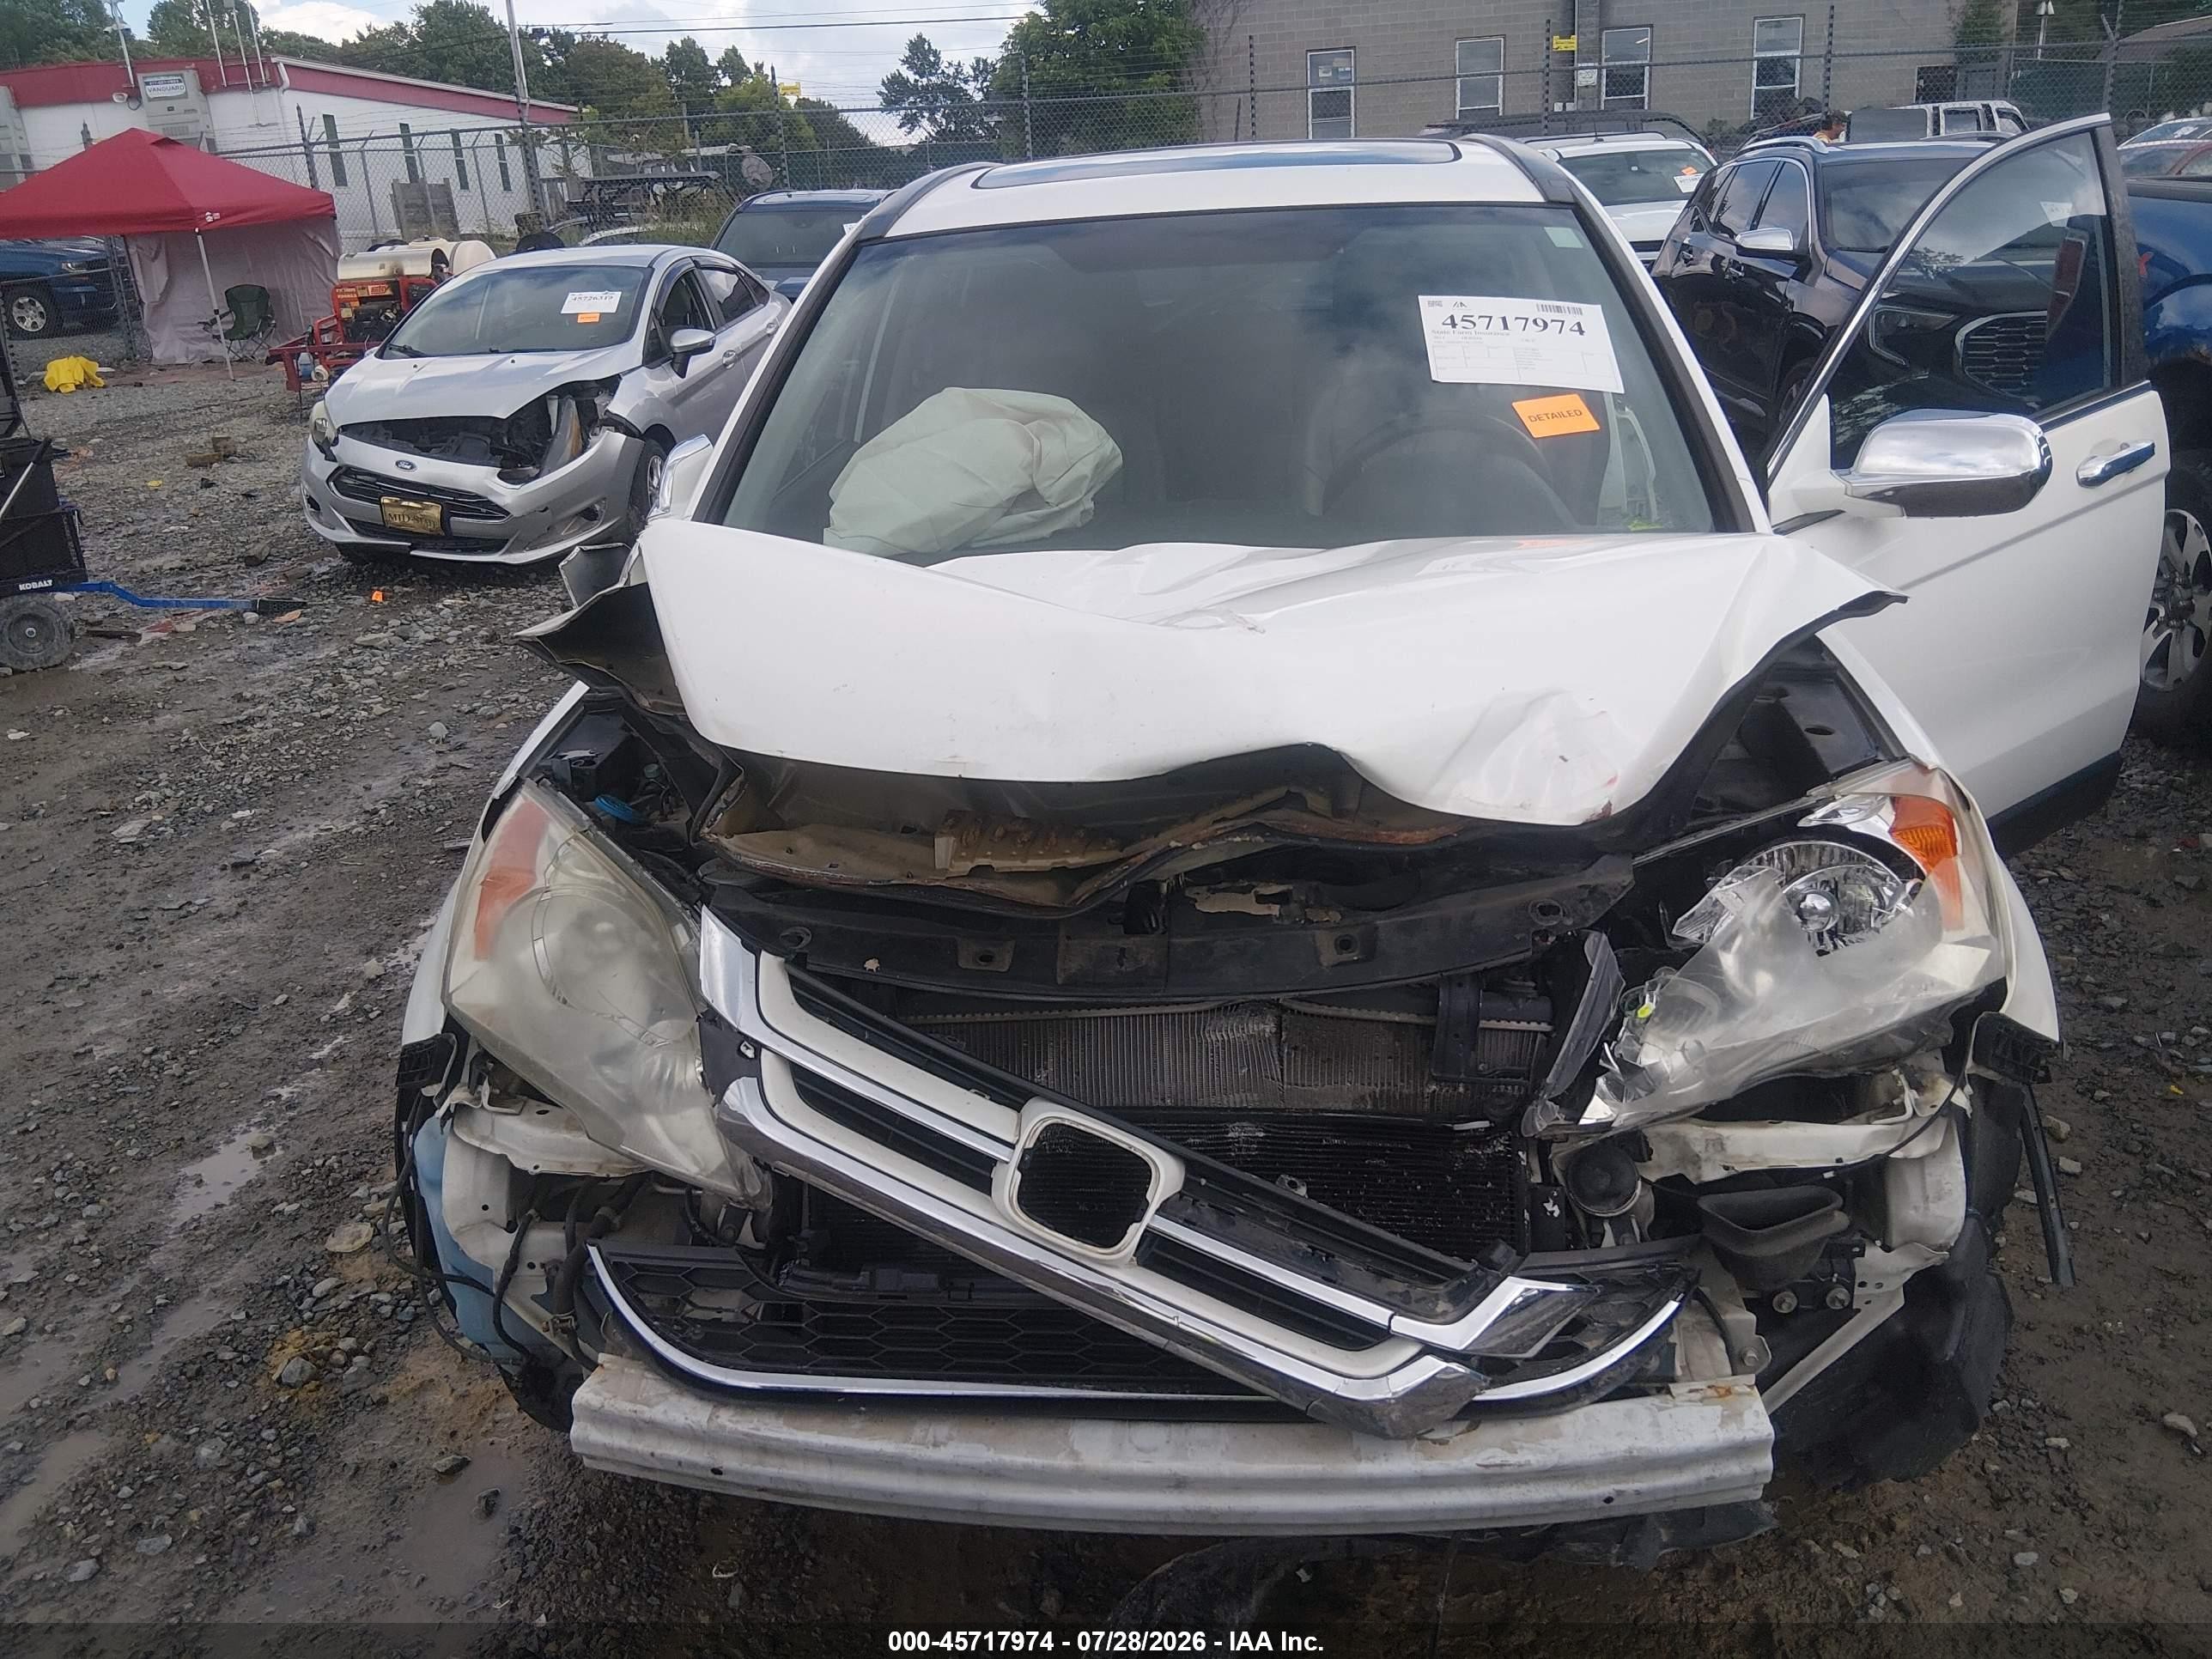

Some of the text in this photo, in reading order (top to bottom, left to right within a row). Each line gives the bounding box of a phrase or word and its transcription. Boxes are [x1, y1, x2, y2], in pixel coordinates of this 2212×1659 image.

[1442, 313, 1586, 336] 45717974
[1528, 409, 1583, 422] DETAILED
[19, 579, 53, 591] KOBALT
